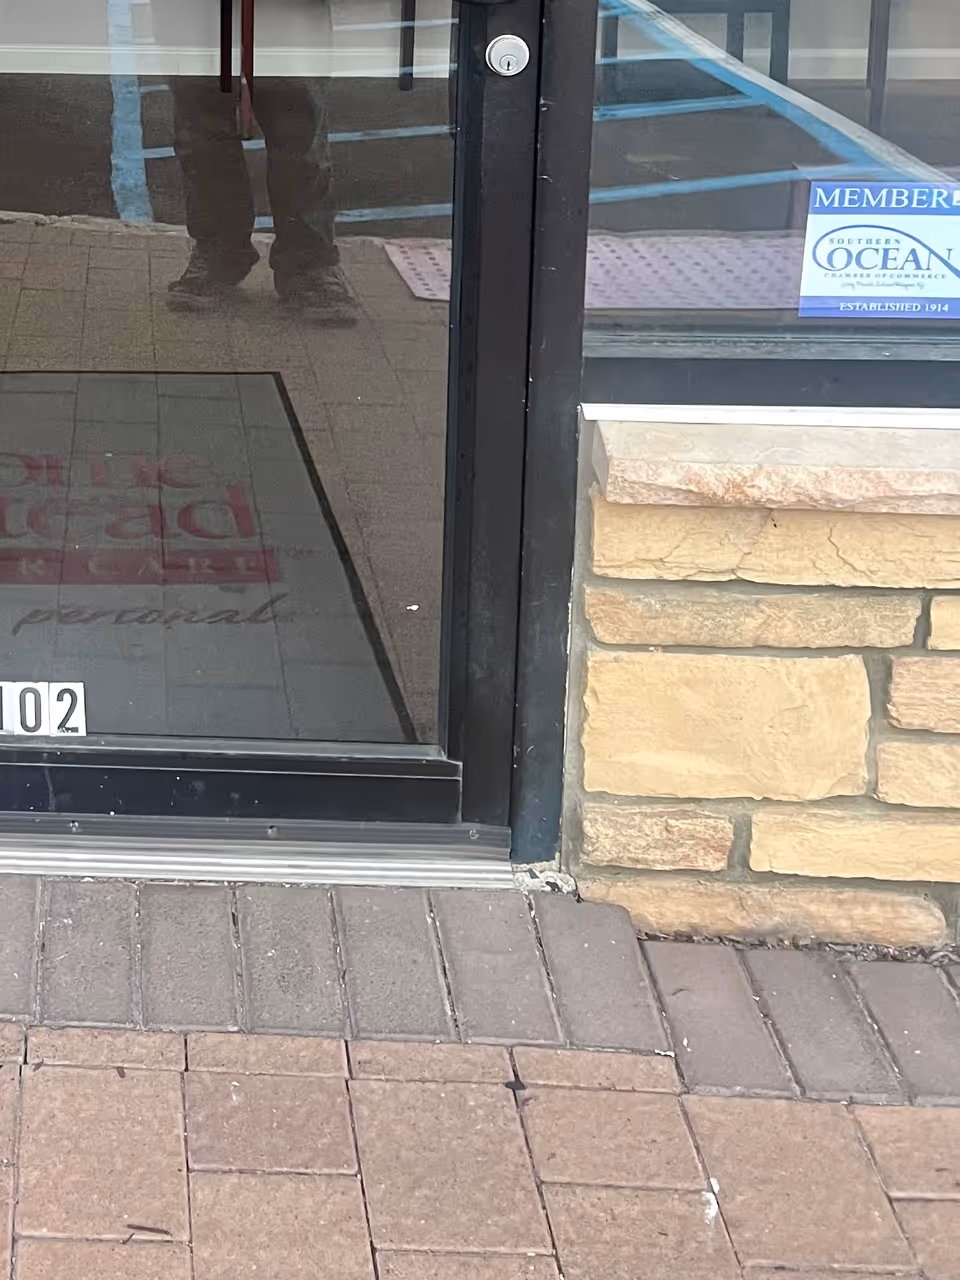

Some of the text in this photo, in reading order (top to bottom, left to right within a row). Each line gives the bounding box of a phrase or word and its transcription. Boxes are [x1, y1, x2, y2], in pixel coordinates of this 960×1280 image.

[813, 187, 951, 209] MEMBER
[828, 237, 902, 246] SOUTHERN
[826, 246, 955, 272] OCEAN
[839, 301, 950, 313] ESTABLISHED 1914
[87, 554, 265, 577] CARE
[8, 591, 290, 636] personal
